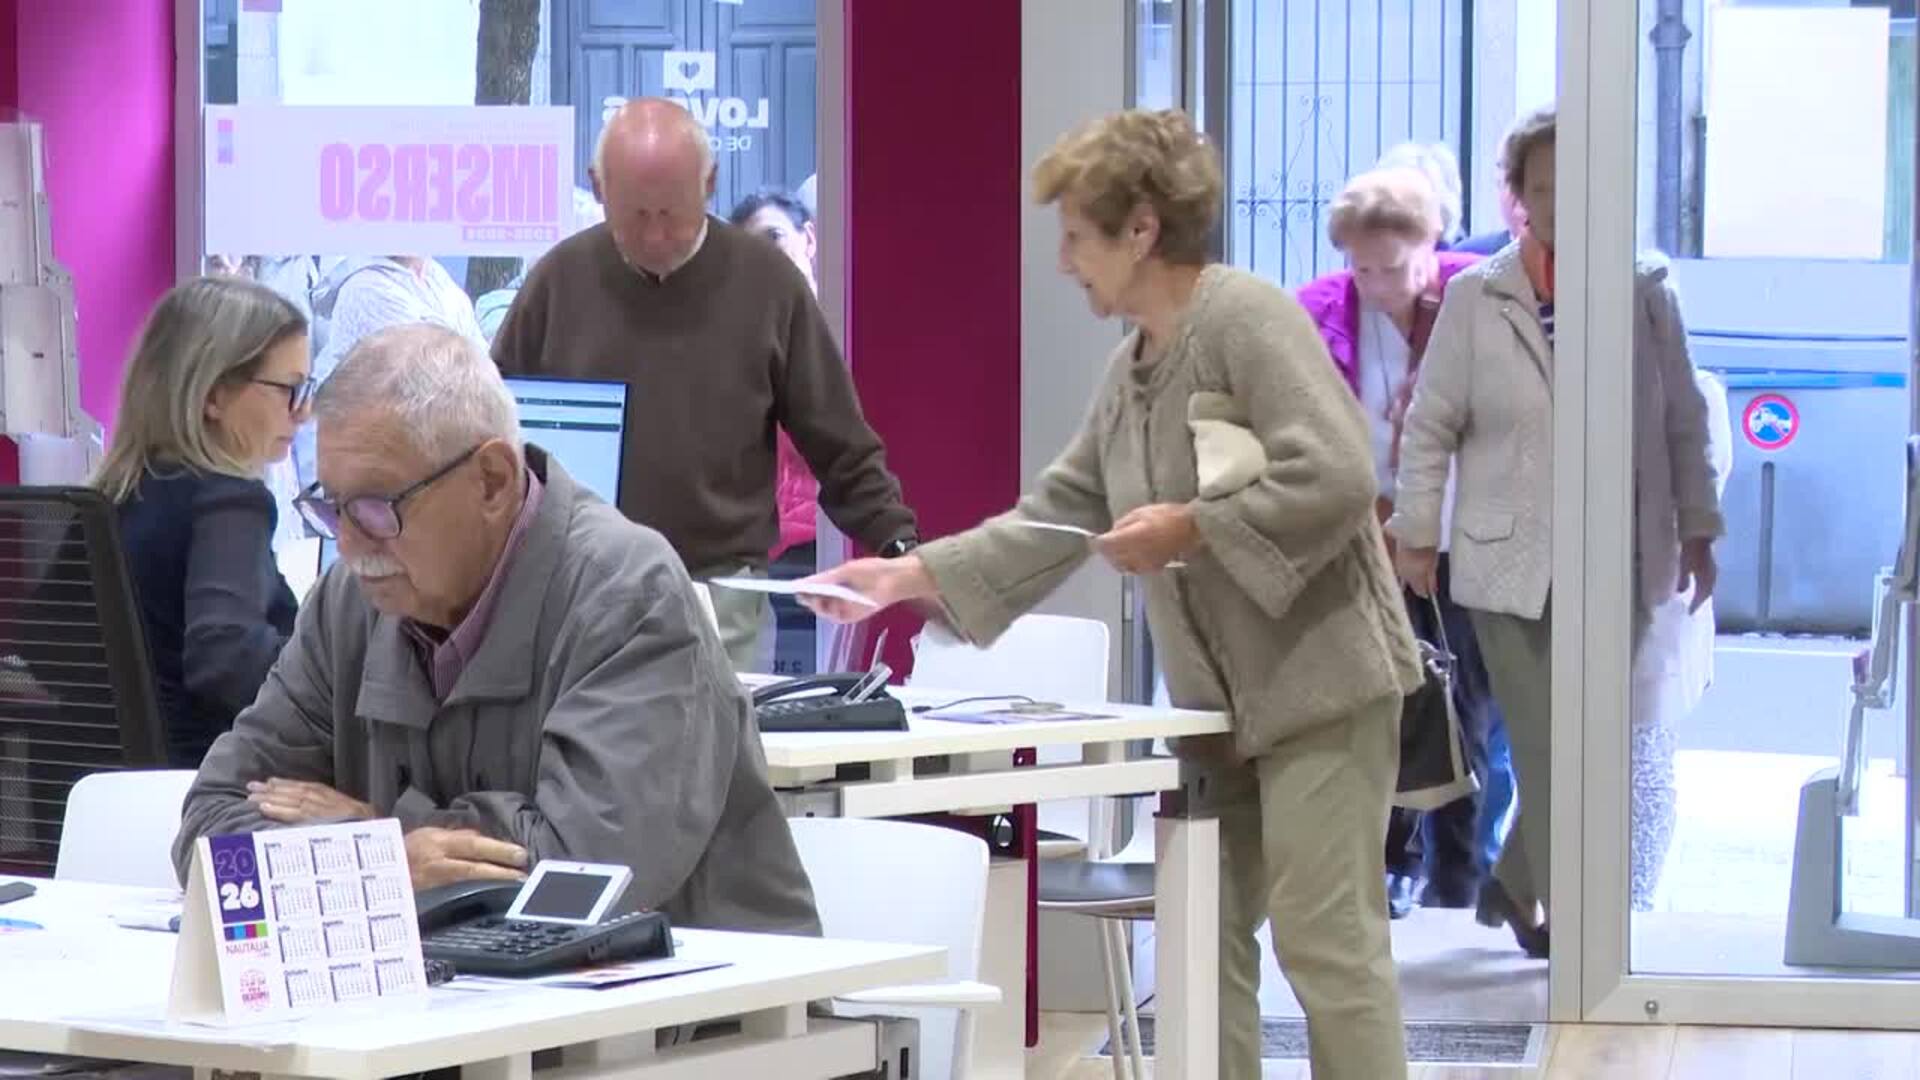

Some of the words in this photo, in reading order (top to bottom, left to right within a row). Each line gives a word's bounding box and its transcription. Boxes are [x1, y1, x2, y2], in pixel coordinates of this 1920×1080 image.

[215, 848, 256, 879] 20
[220, 881, 260, 911] 26
[225, 941, 270, 955] NAUTALIA
